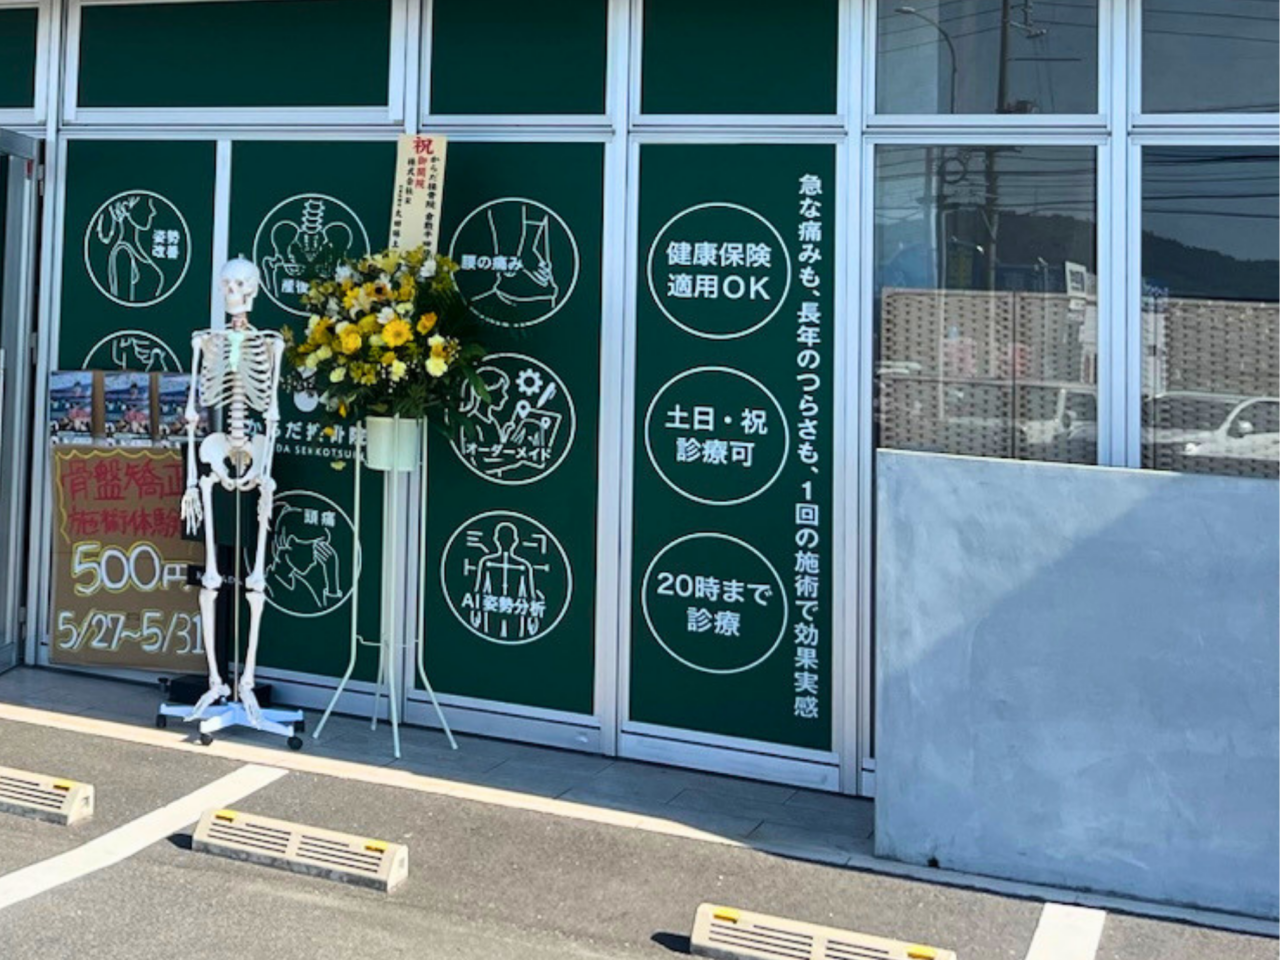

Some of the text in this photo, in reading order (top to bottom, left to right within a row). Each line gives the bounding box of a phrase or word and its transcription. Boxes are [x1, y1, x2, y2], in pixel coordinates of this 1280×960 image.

[413, 136, 434, 155] 祝
[666, 241, 772, 268] 健康保険
[667, 273, 771, 300] 適用OK
[664, 404, 768, 435] 土日・祝
[676, 437, 755, 467] 診療可
[304, 508, 336, 528] 頭痛
[657, 572, 773, 606] 20時まで
[687, 607, 741, 636] 診療
